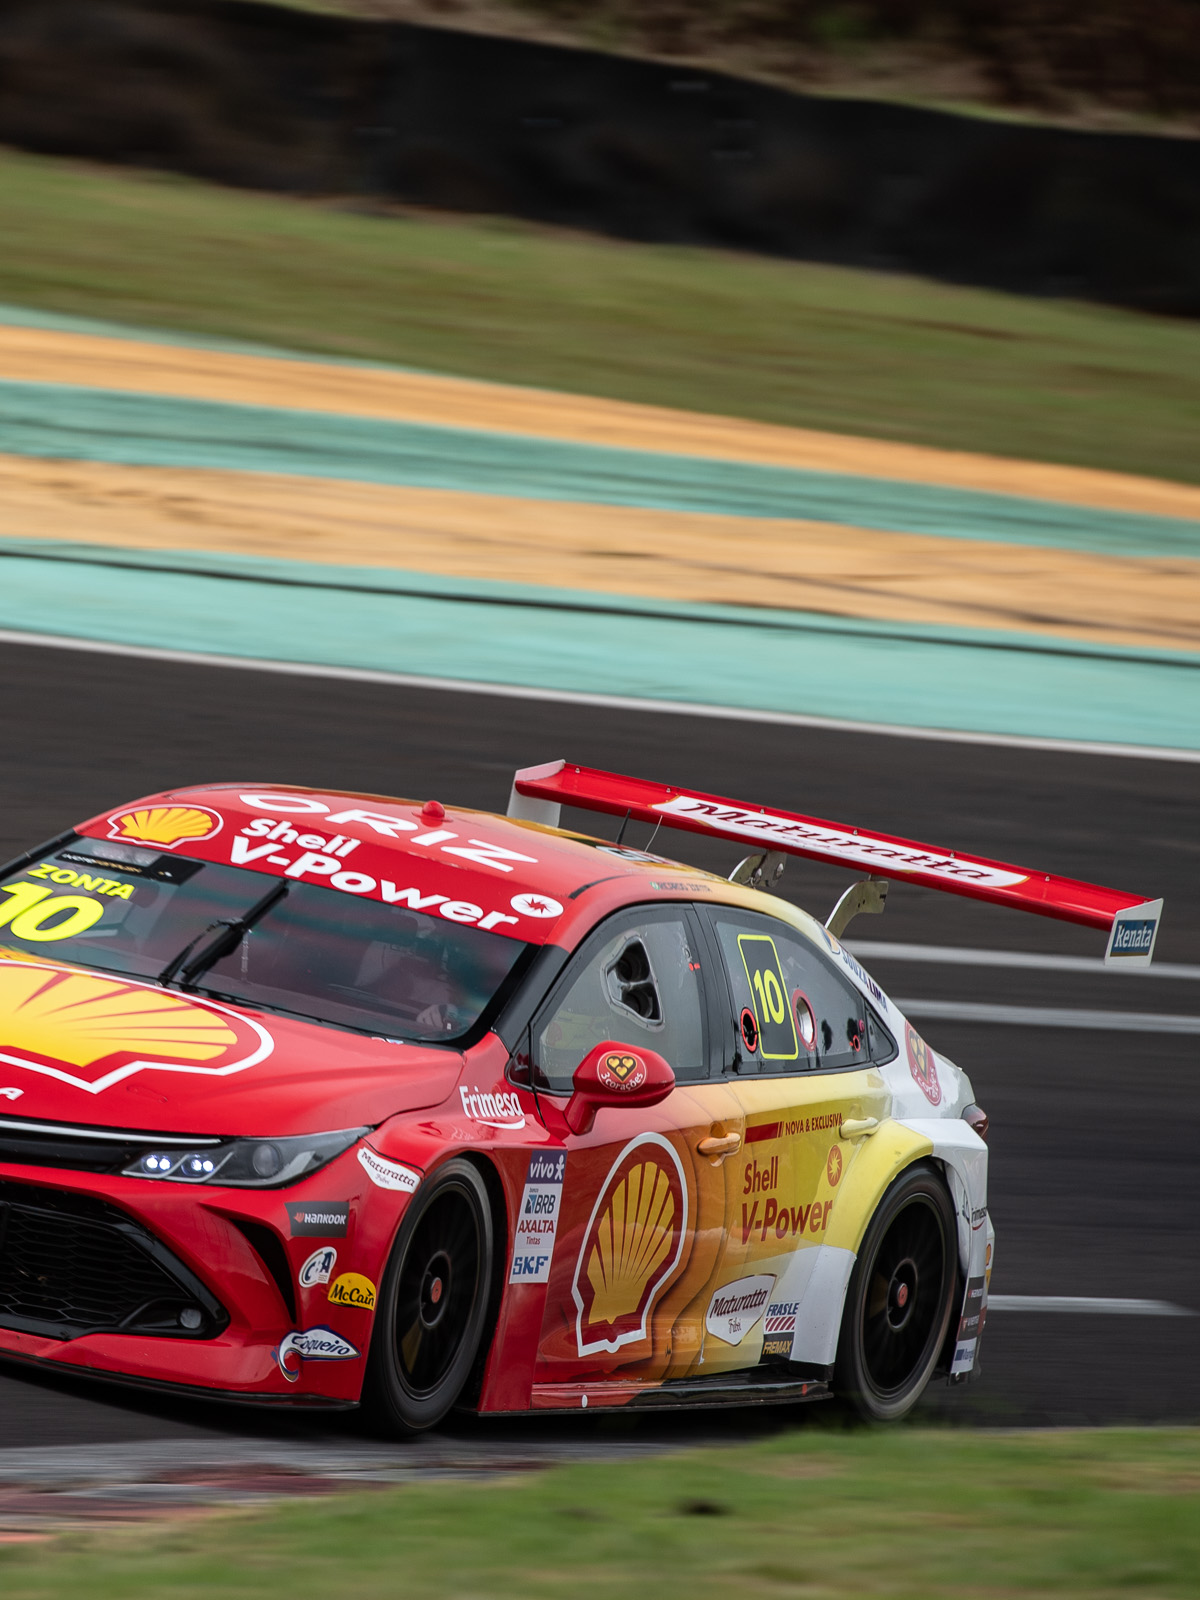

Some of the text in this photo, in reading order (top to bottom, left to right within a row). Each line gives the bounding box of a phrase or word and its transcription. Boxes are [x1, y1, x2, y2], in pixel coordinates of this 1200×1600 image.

[241, 818, 361, 858] Shell
[677, 801, 994, 880] Maturatta
[26, 863, 136, 900] ZONTA
[230, 835, 519, 930] V-Power
[753, 969, 785, 1025] 10
[459, 1085, 525, 1119] Frimesa
[785, 1112, 843, 1136] NOVA & EXCLUSIVA
[361, 1151, 416, 1188] Maturatta
[530, 1155, 554, 1179] vivo
[743, 1155, 778, 1195] Shell
[534, 1194, 556, 1215] BRB
[518, 1219, 555, 1234] AXALTA
[742, 1197, 833, 1246] V-Power
[526, 1236, 541, 1246] Tintas
[512, 1255, 549, 1275] SKF
[330, 1283, 375, 1307] McCain
[709, 1288, 768, 1319] Maturatta
[292, 1335, 350, 1355] Coqueiro
[762, 1340, 793, 1355] FREMAX
